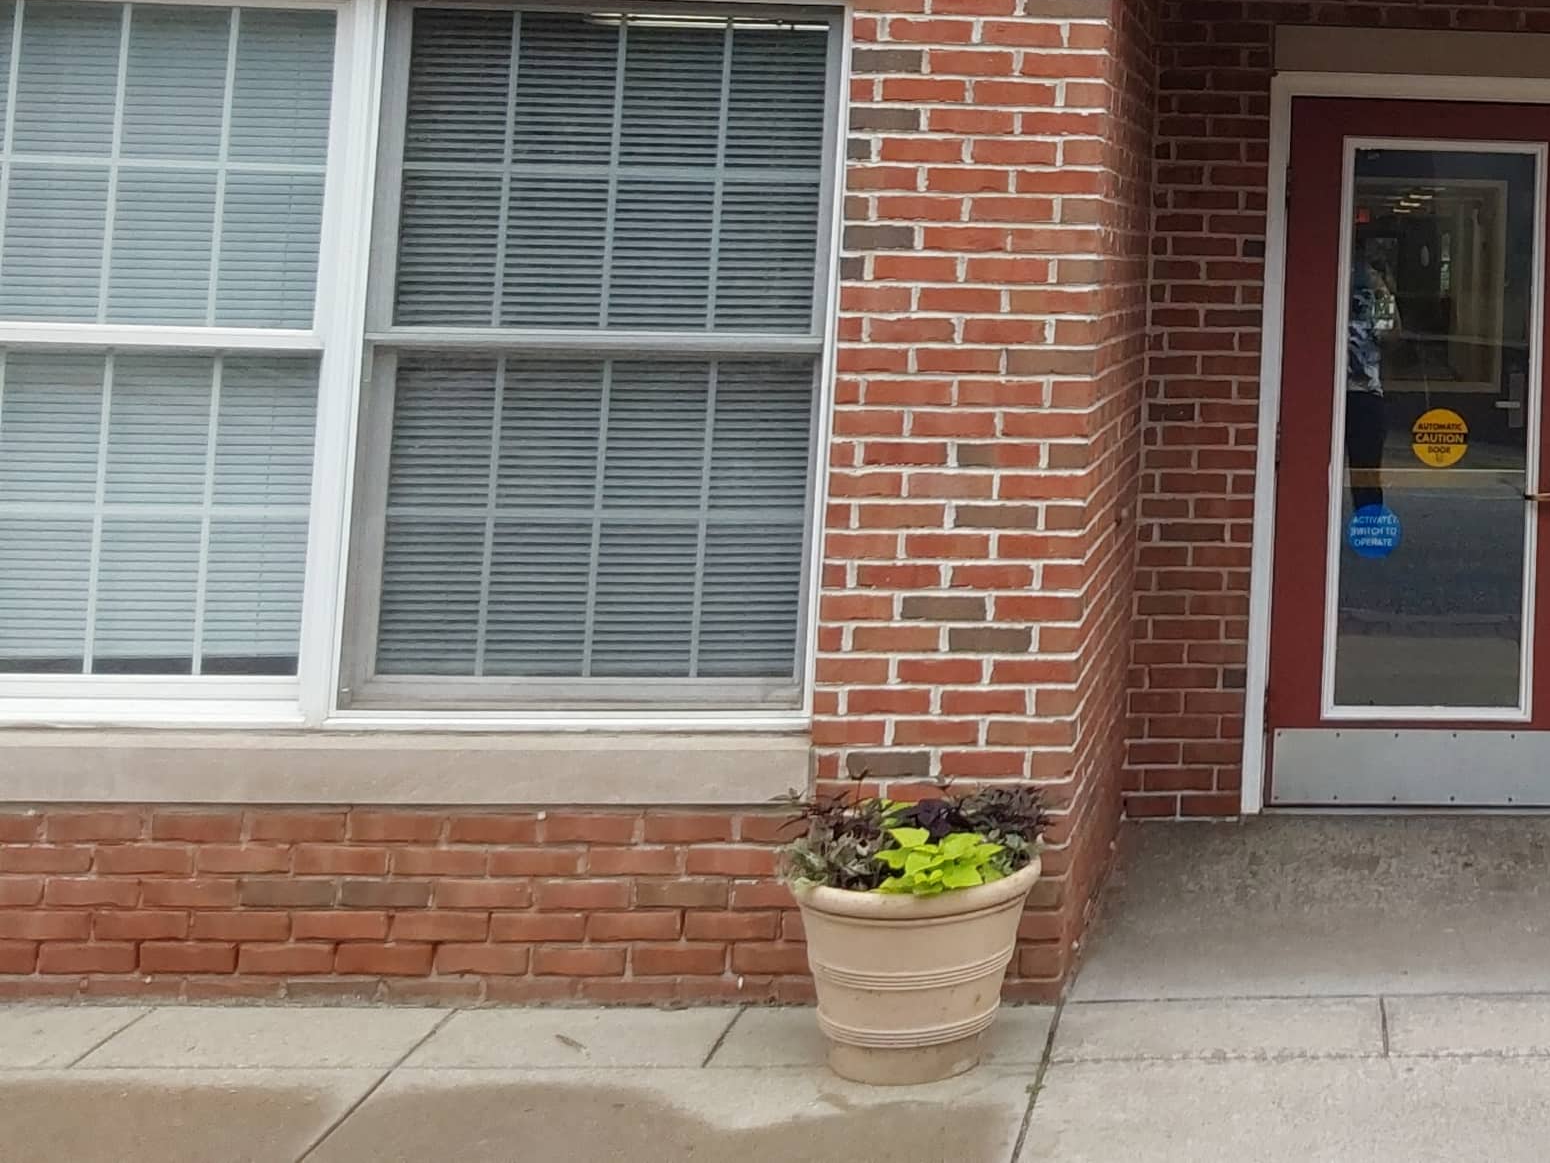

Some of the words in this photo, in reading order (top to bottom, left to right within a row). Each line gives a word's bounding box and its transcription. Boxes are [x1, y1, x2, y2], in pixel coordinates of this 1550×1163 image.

[1417, 422, 1464, 431] AUTOMATIC
[1415, 433, 1465, 444] CAUTION
[1427, 445, 1452, 454] DOOR
[1386, 526, 1398, 535] TO
[1354, 537, 1393, 547] OPERATE
